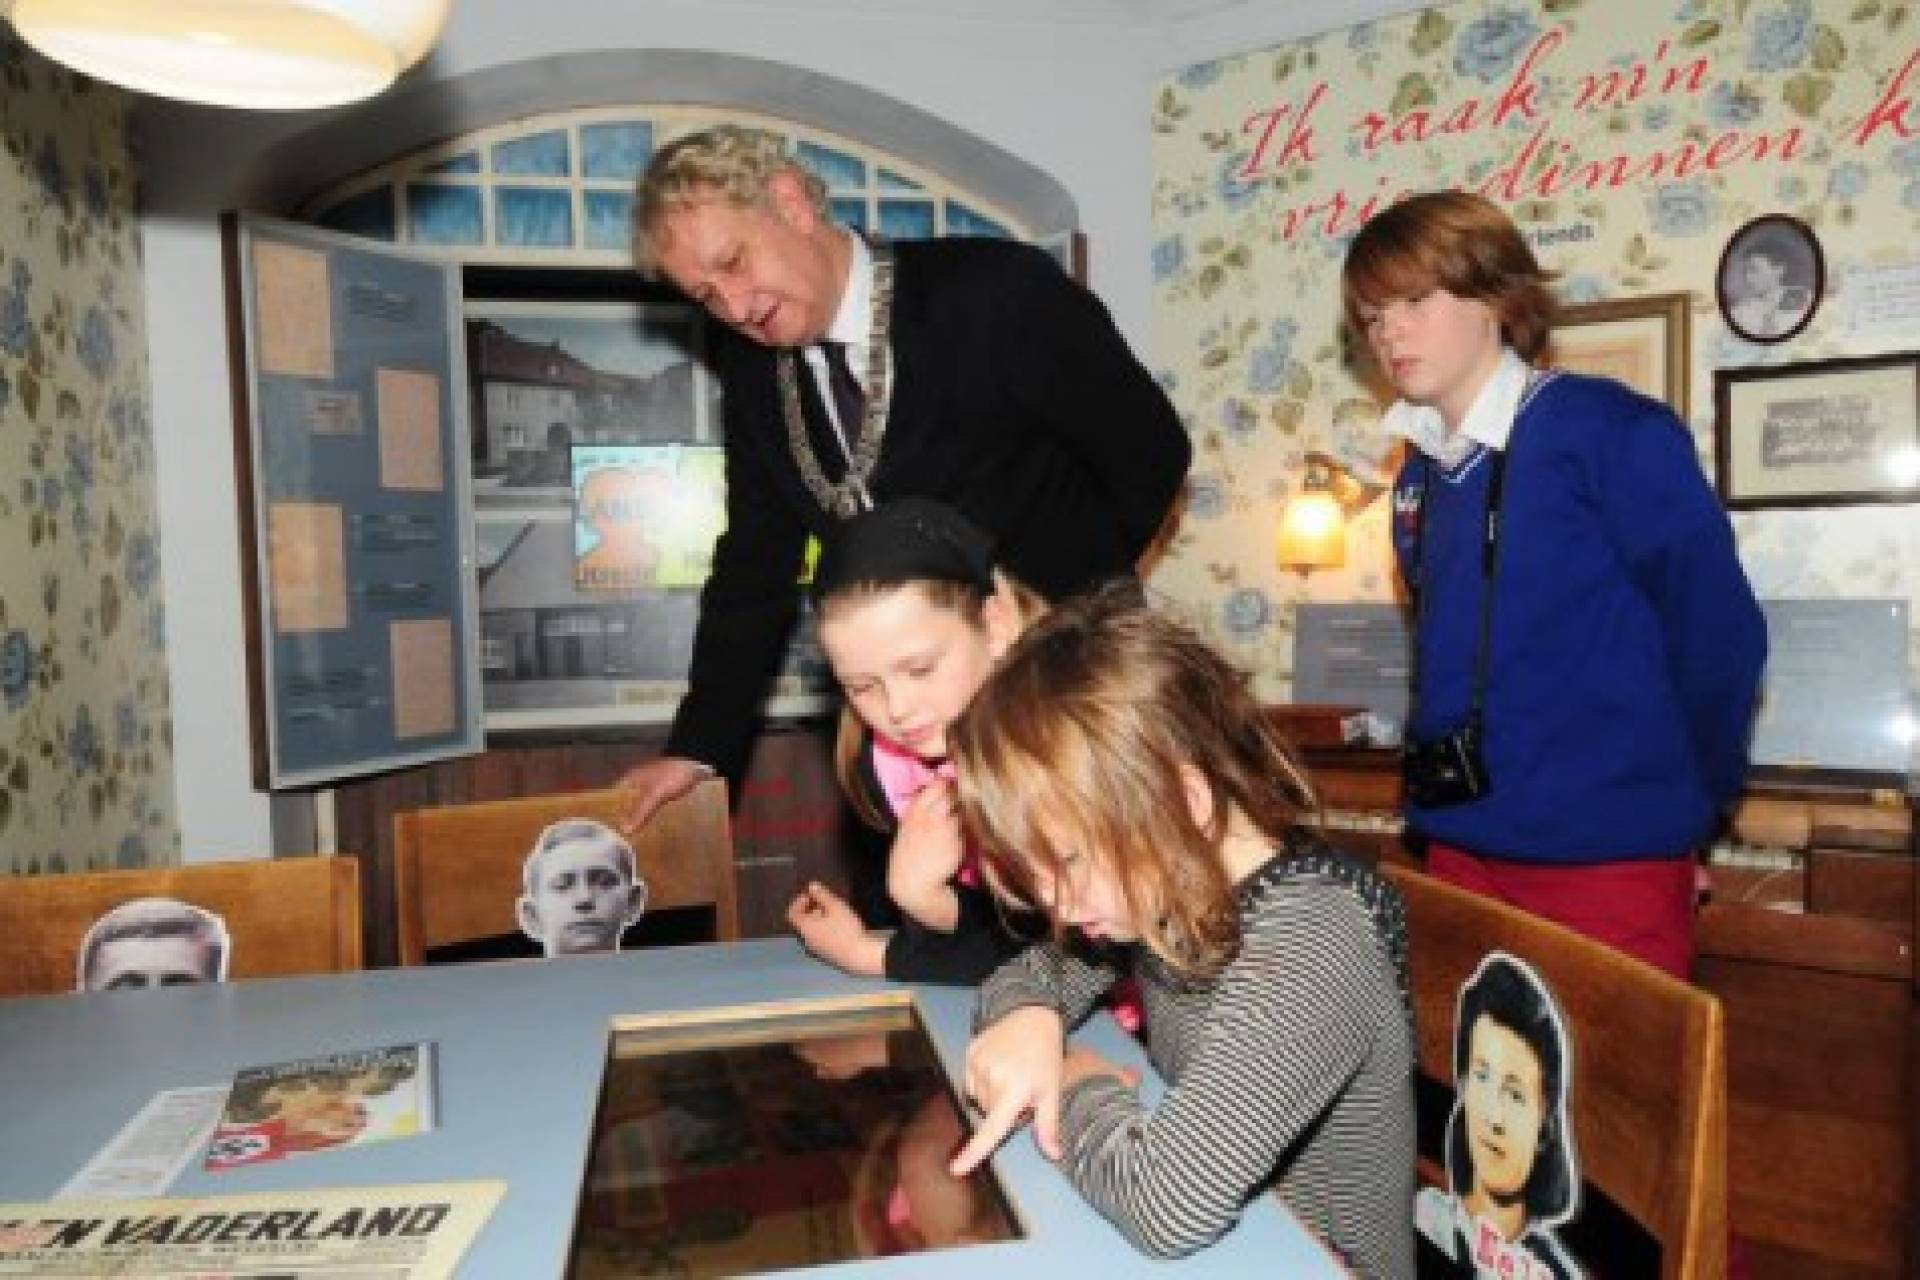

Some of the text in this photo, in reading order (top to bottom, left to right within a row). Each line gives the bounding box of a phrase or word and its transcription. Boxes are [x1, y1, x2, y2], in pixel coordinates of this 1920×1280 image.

[1240, 79, 1330, 179] Ik
[1352, 26, 1570, 153] raak
[102, 1202, 453, 1247] VADERLAND
